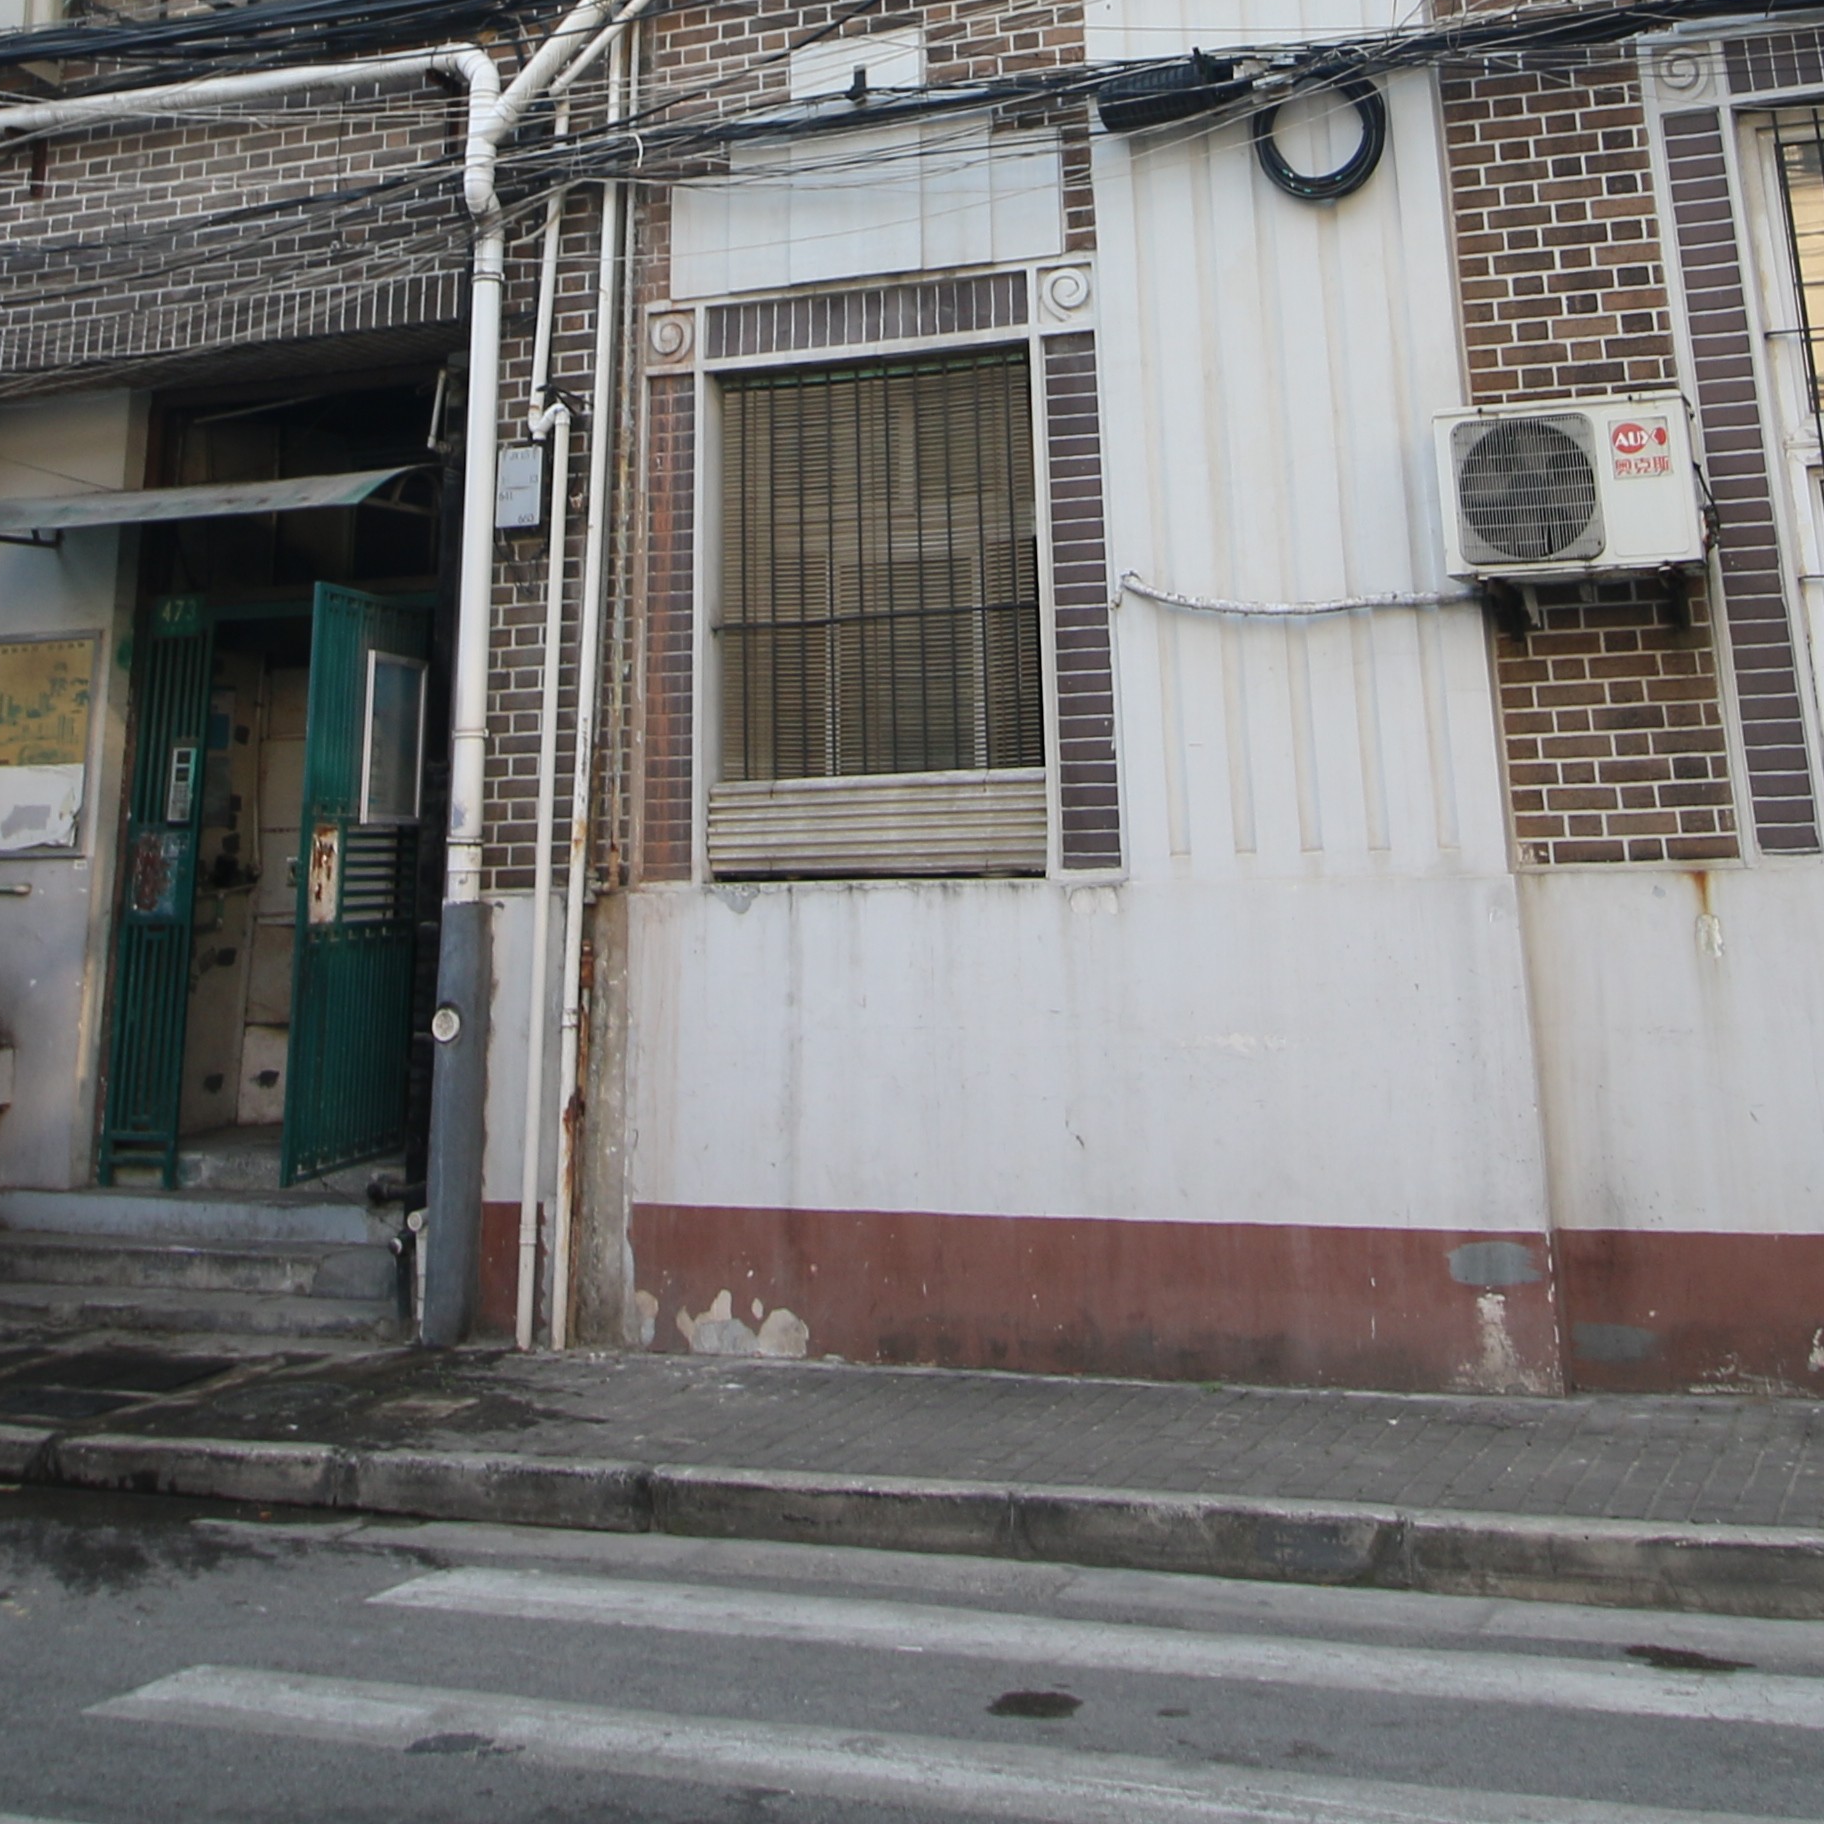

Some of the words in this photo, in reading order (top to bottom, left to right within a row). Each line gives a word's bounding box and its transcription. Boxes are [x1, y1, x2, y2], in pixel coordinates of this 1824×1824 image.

[1614, 427, 1663, 448] AUX
[1615, 456, 1669, 475] 奥克斯
